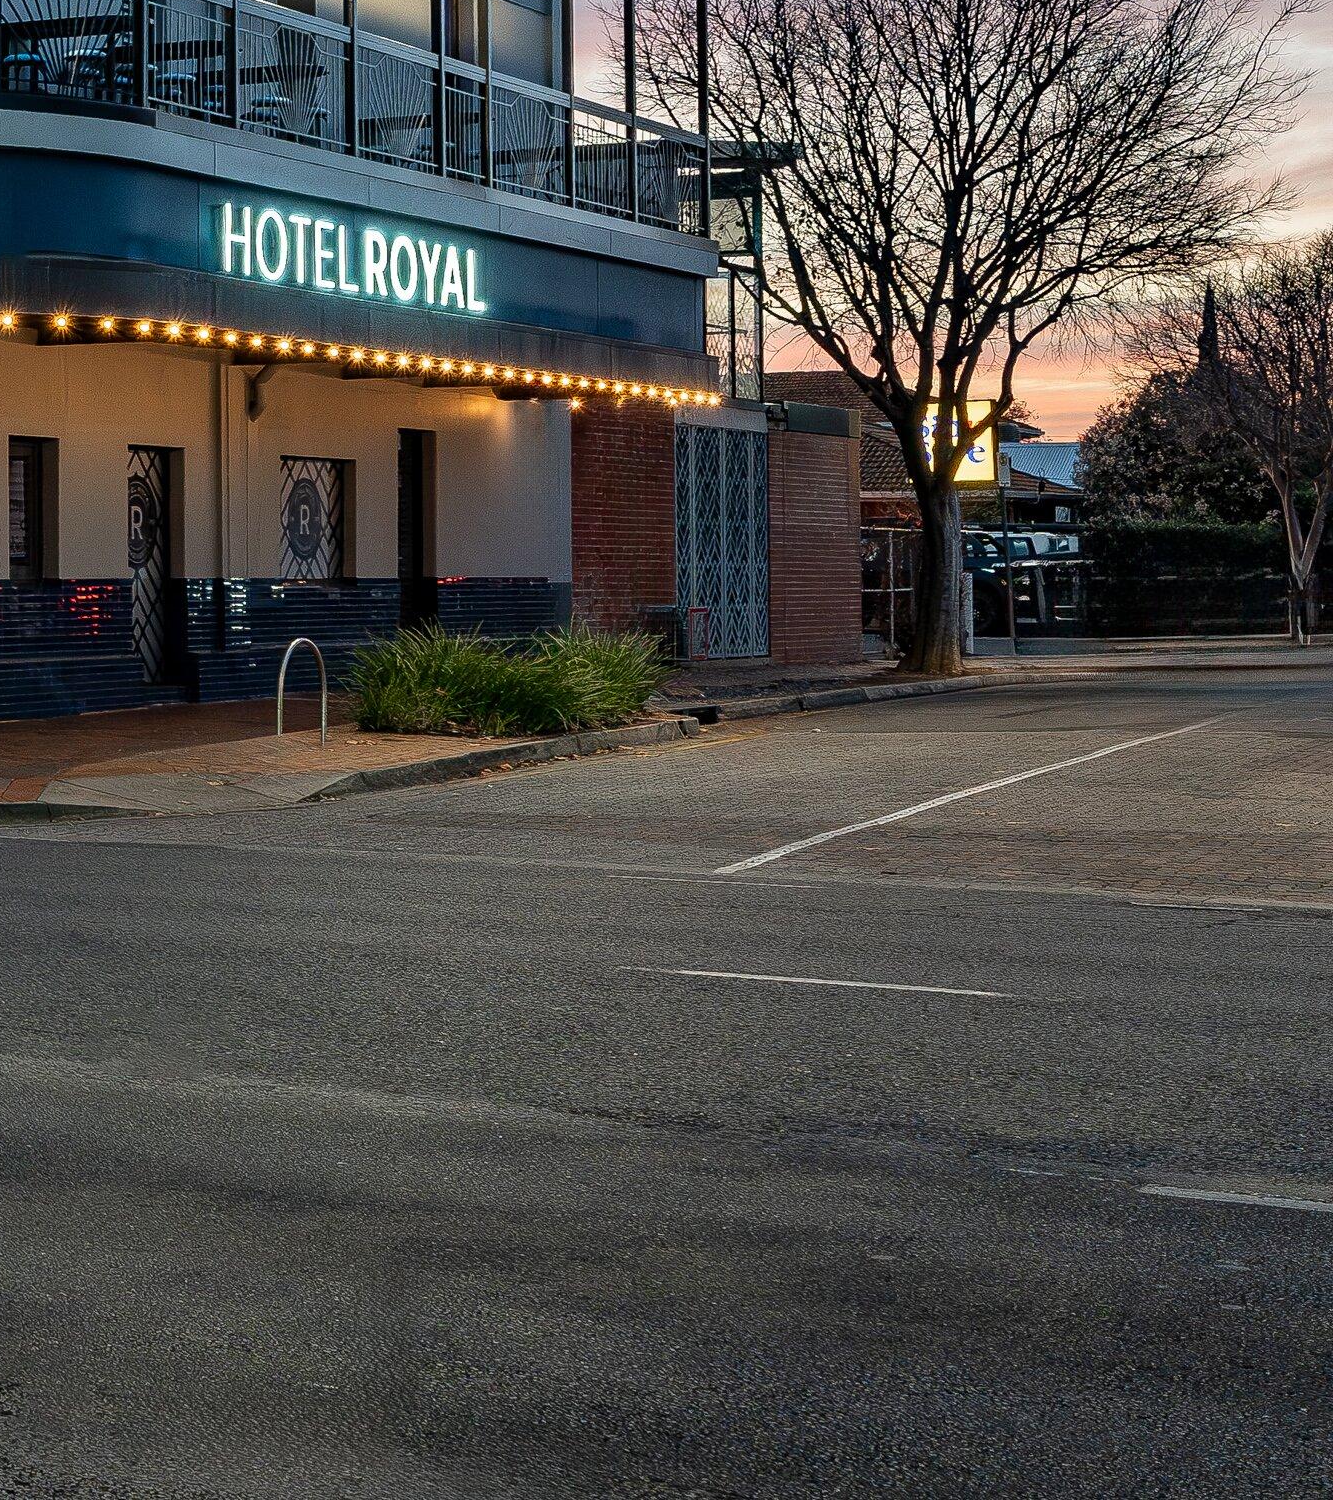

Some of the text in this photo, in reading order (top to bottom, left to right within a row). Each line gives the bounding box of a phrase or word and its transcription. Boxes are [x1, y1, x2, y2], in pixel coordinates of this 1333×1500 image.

[222, 202, 486, 312] HOTEL ROYAL
[131, 505, 143, 539] R
[300, 504, 310, 534] R
